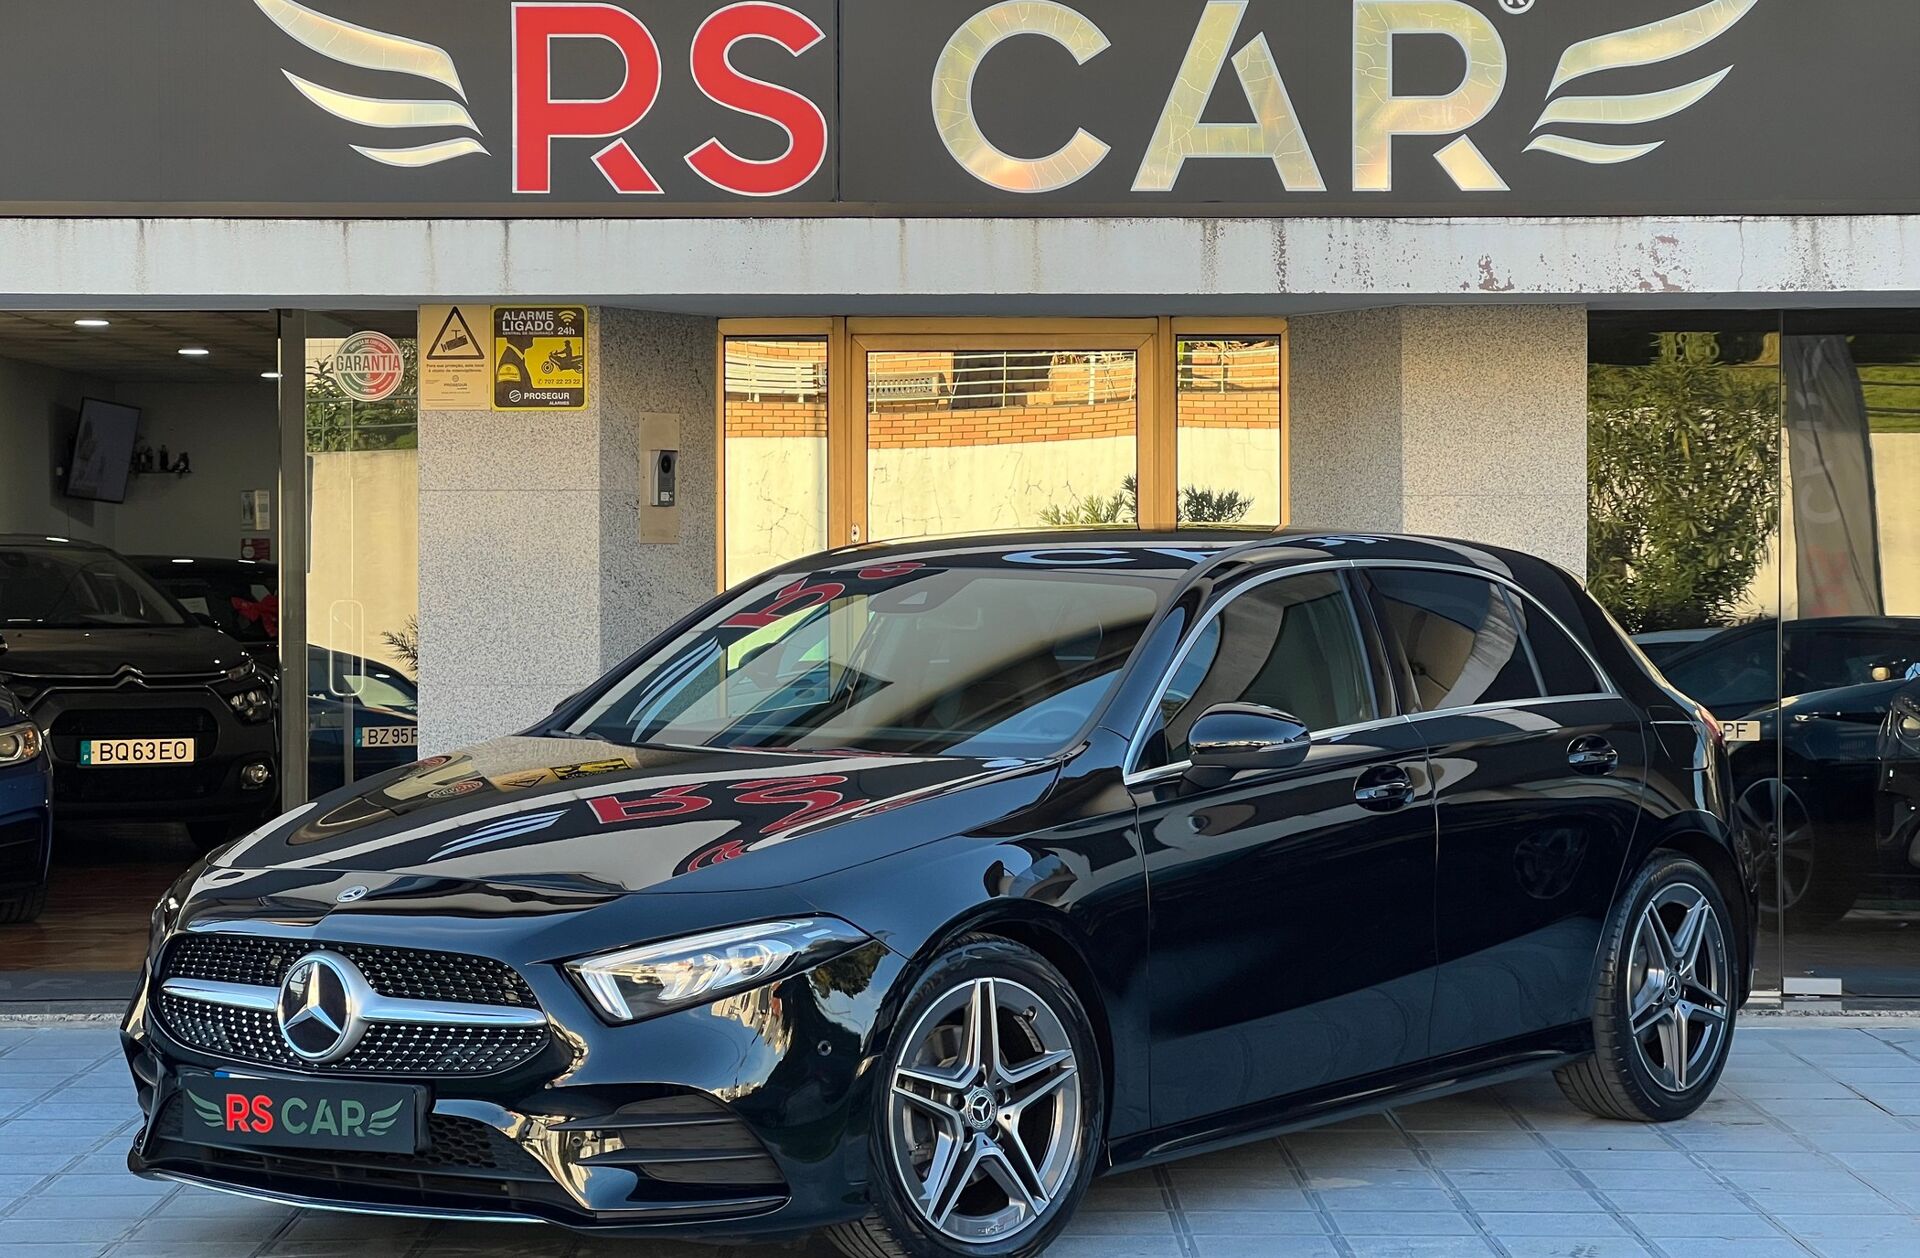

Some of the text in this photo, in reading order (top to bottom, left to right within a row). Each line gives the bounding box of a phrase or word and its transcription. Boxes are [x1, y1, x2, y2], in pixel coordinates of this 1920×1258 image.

[511, 0, 1512, 197] RS CAR
[502, 311, 554, 321] ALARME
[502, 321, 554, 331] LIGADO
[557, 326, 575, 335] 24h
[336, 354, 401, 371] GARANTIA
[523, 392, 570, 400] PROSEGUR
[1723, 722, 1748, 739] PF
[225, 1093, 367, 1137] RS CAR
